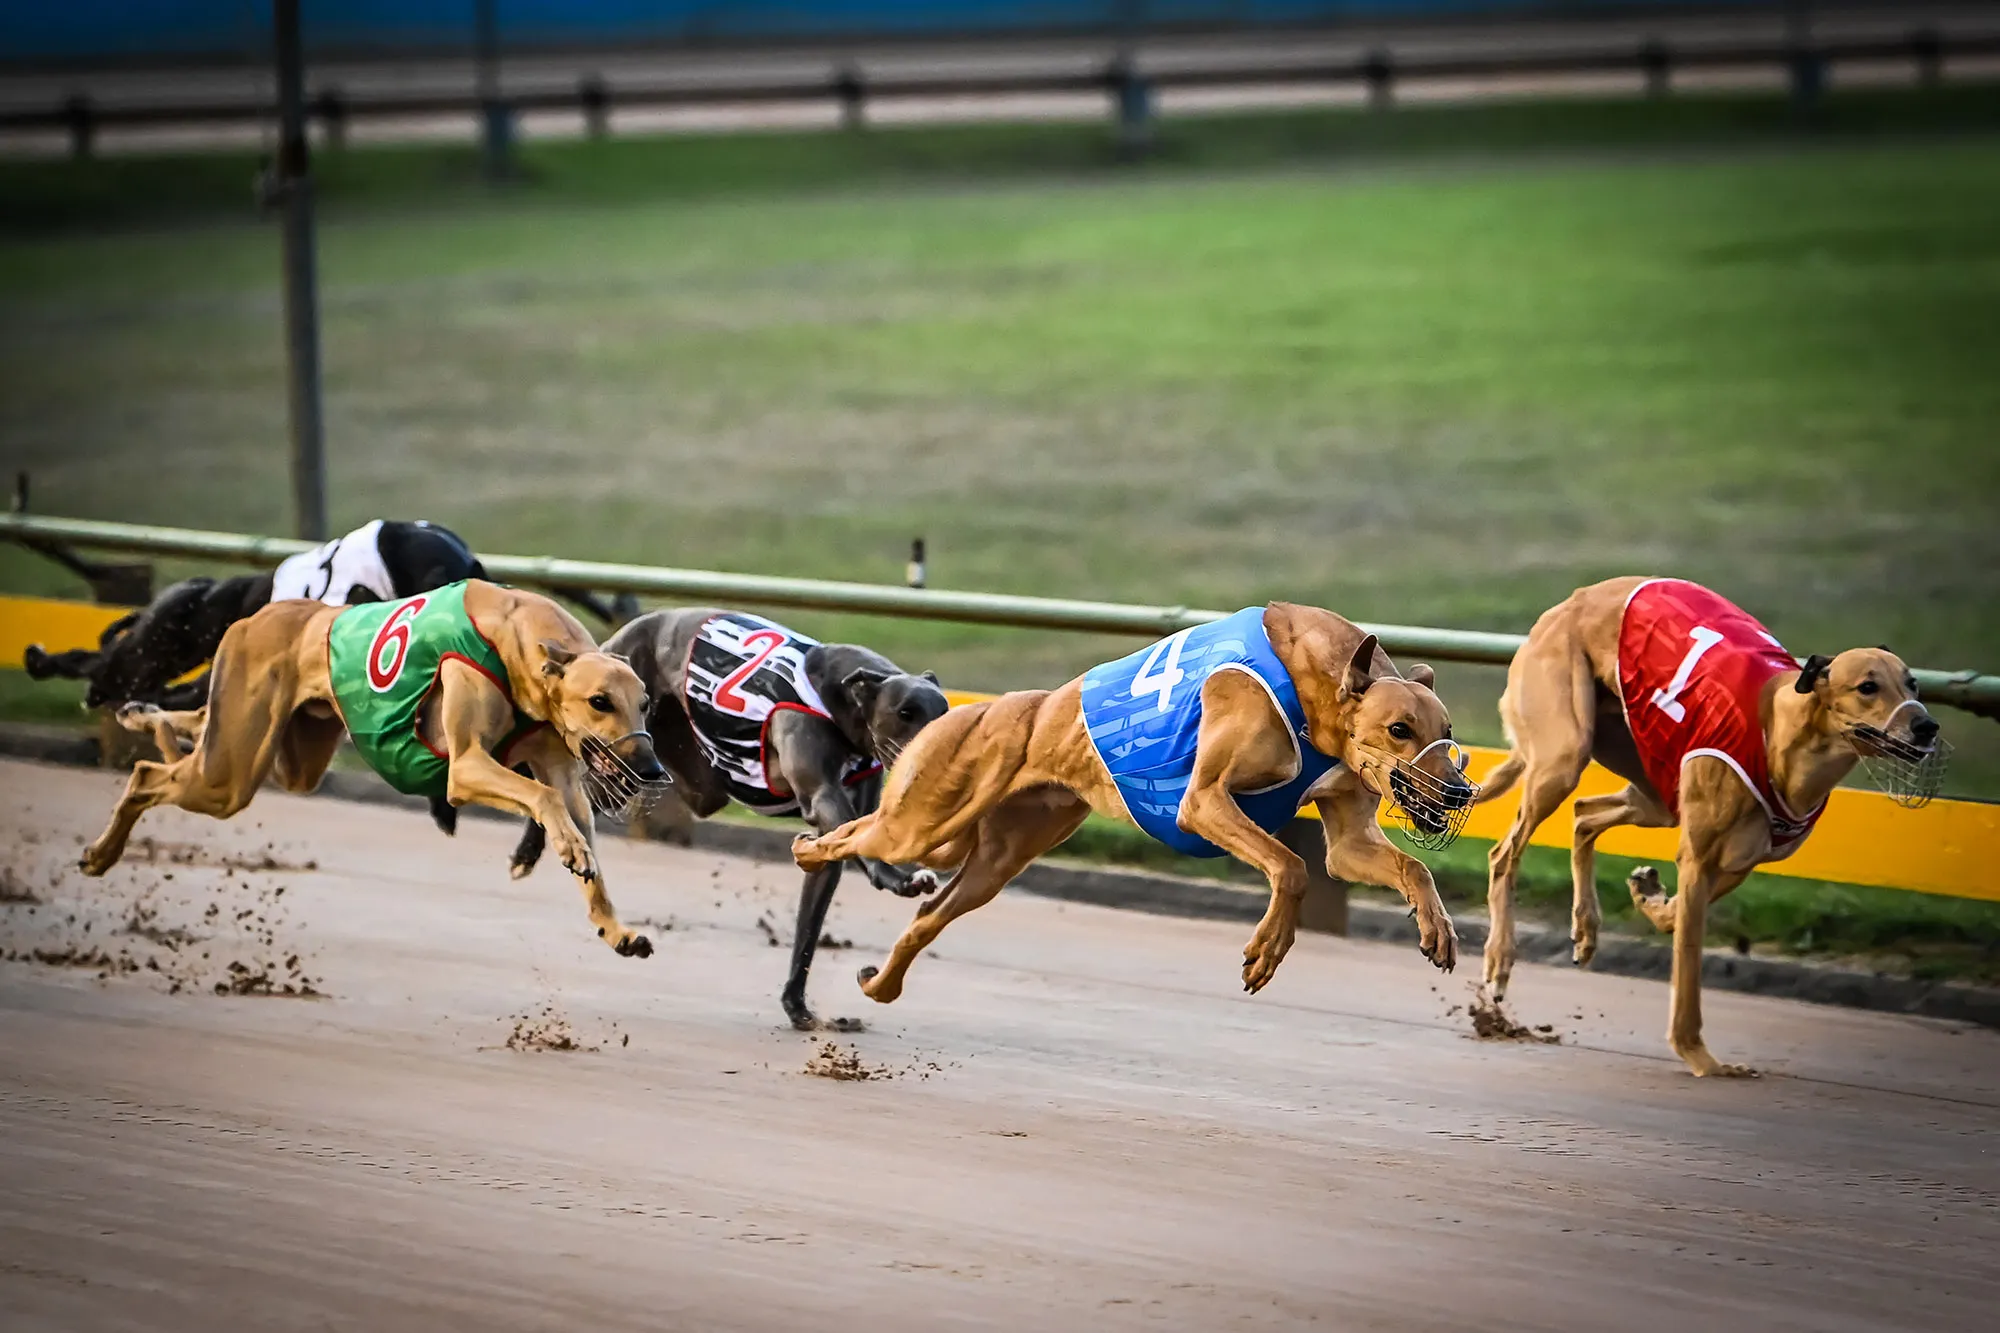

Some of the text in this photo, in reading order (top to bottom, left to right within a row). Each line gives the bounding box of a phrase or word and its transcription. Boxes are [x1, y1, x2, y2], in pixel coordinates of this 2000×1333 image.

[367, 595, 428, 692] 6
[713, 629, 786, 714] 2
[1130, 626, 1196, 713] 4
[1650, 625, 1725, 723] 1
